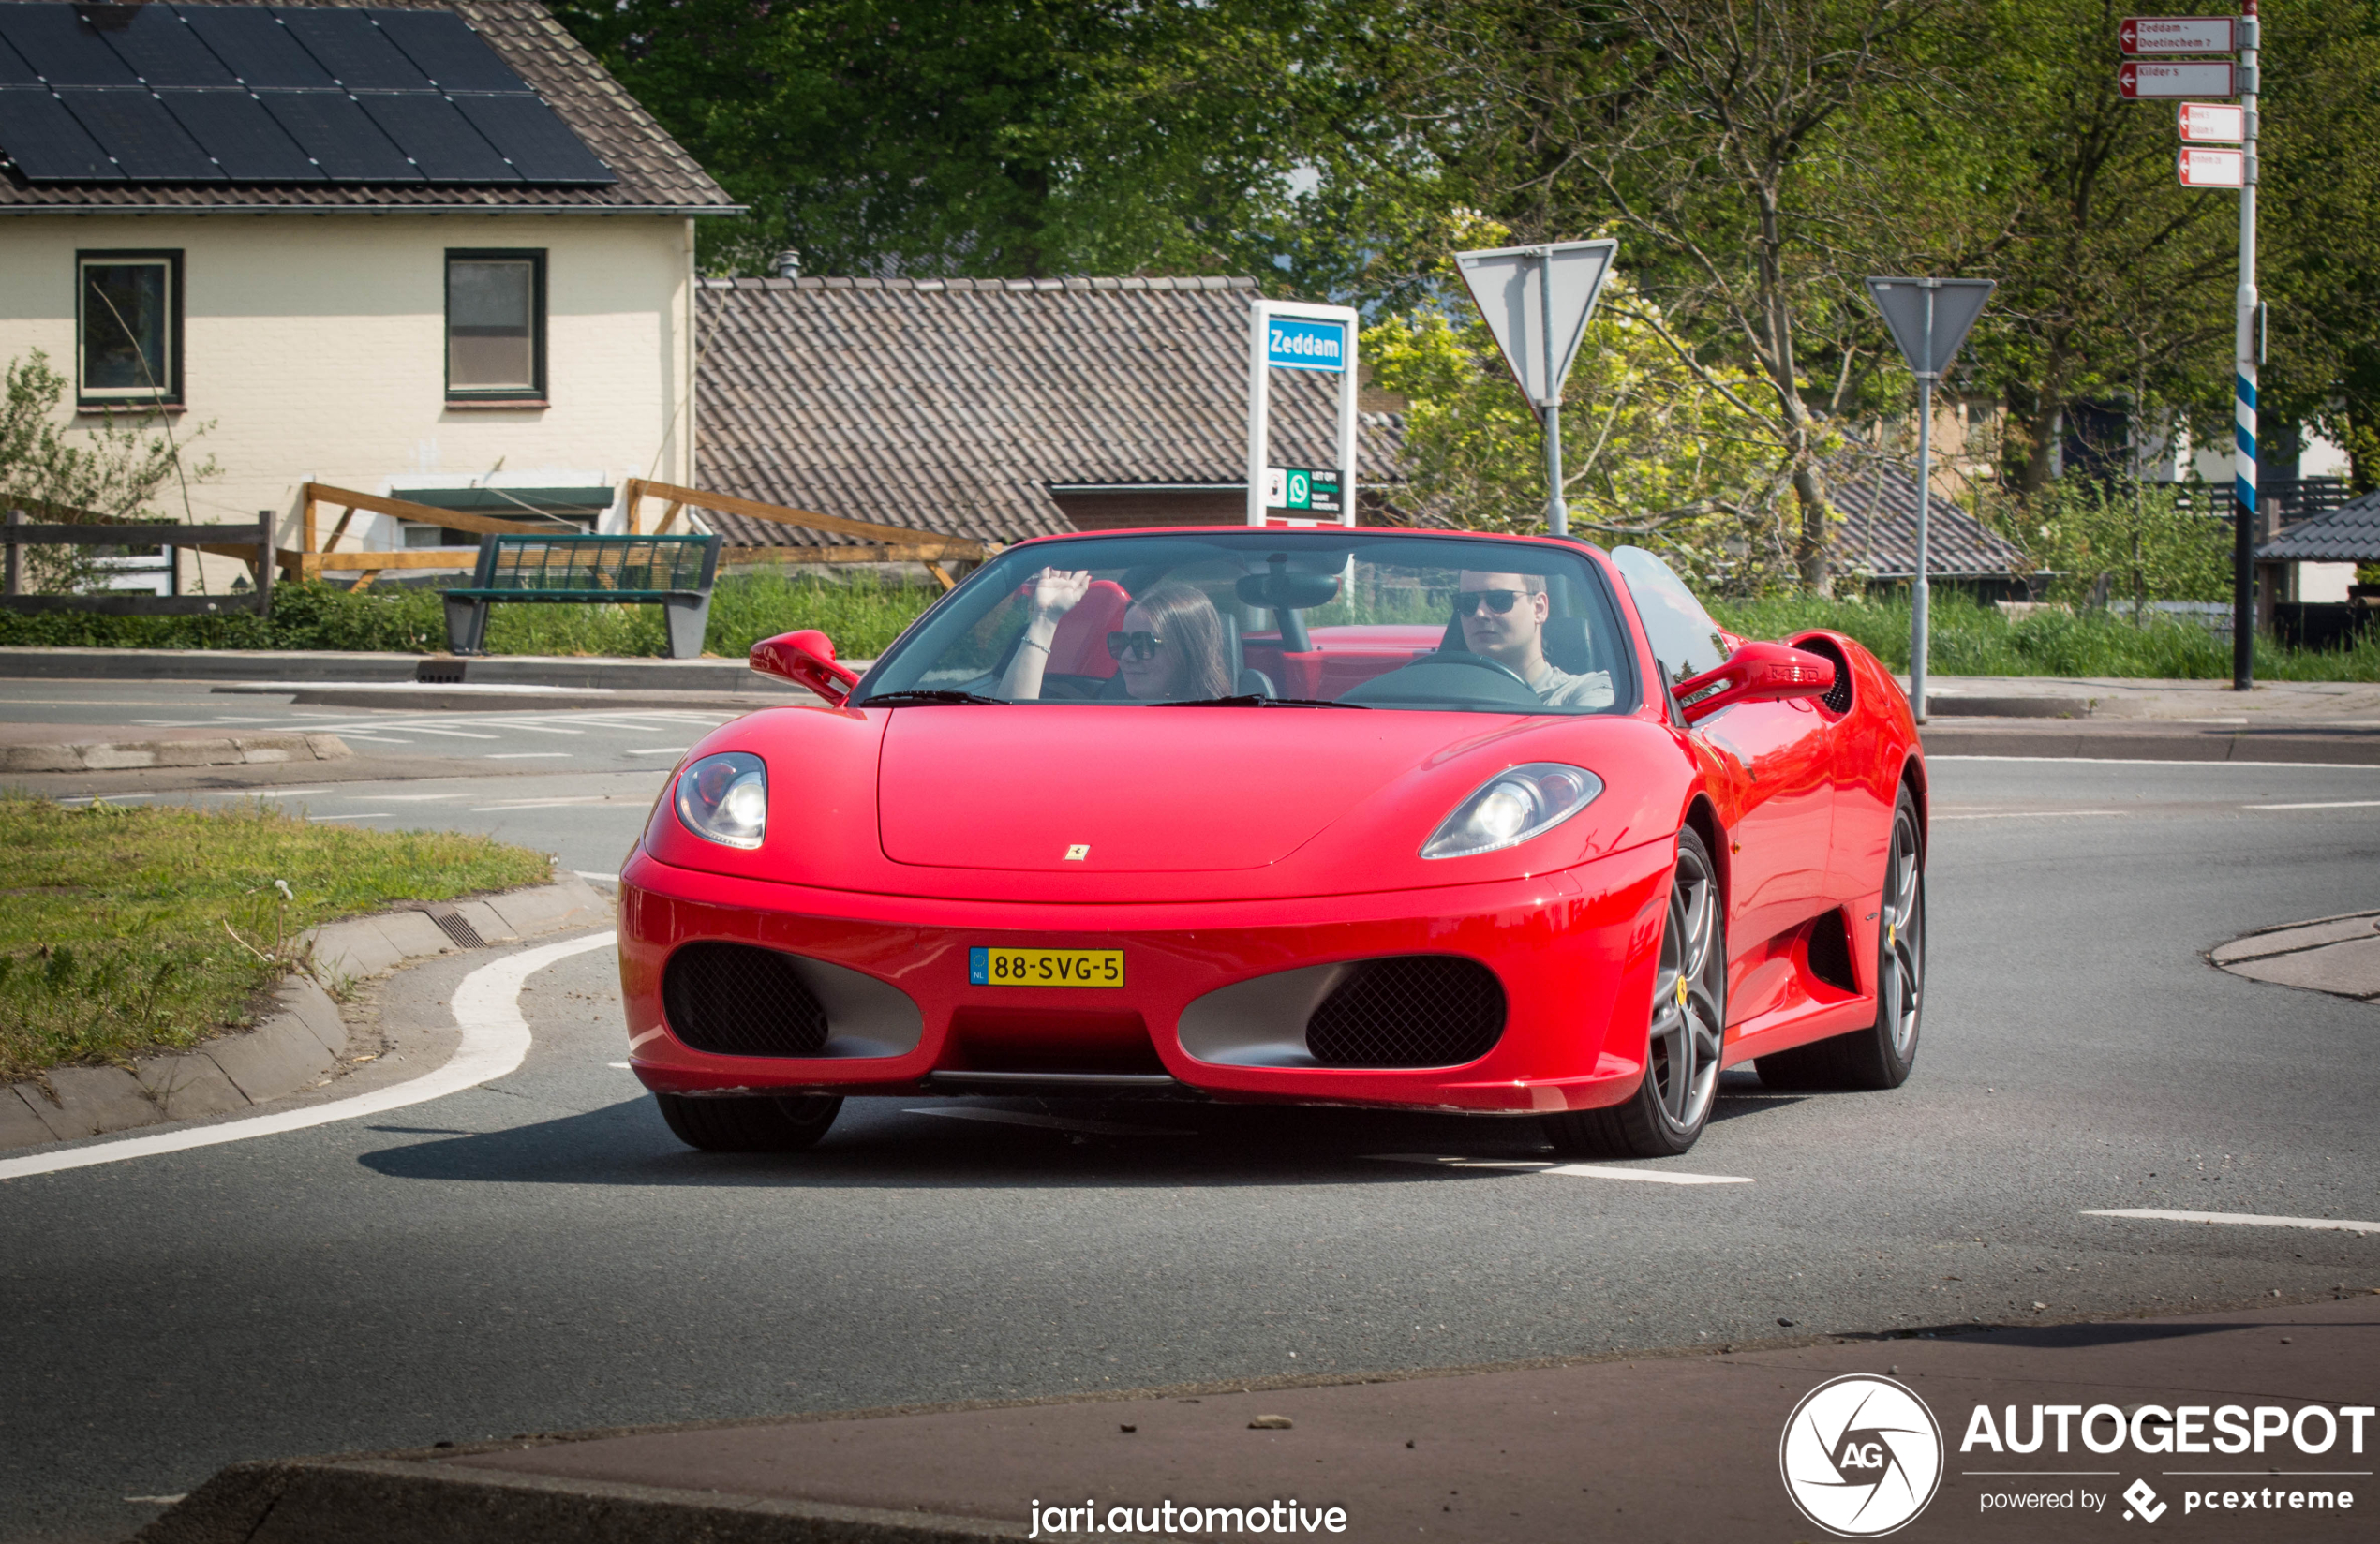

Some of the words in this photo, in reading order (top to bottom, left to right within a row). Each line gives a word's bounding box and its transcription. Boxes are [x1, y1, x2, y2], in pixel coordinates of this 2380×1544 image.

[2139, 23, 2181, 33] Zeddam
[2139, 38, 2203, 48] Doetinchem
[2139, 67, 2170, 77] Kilder
[1271, 329, 1339, 358] Zeddam
[994, 956, 1119, 981] 88-SVG-5
[974, 972, 984, 980] NL
